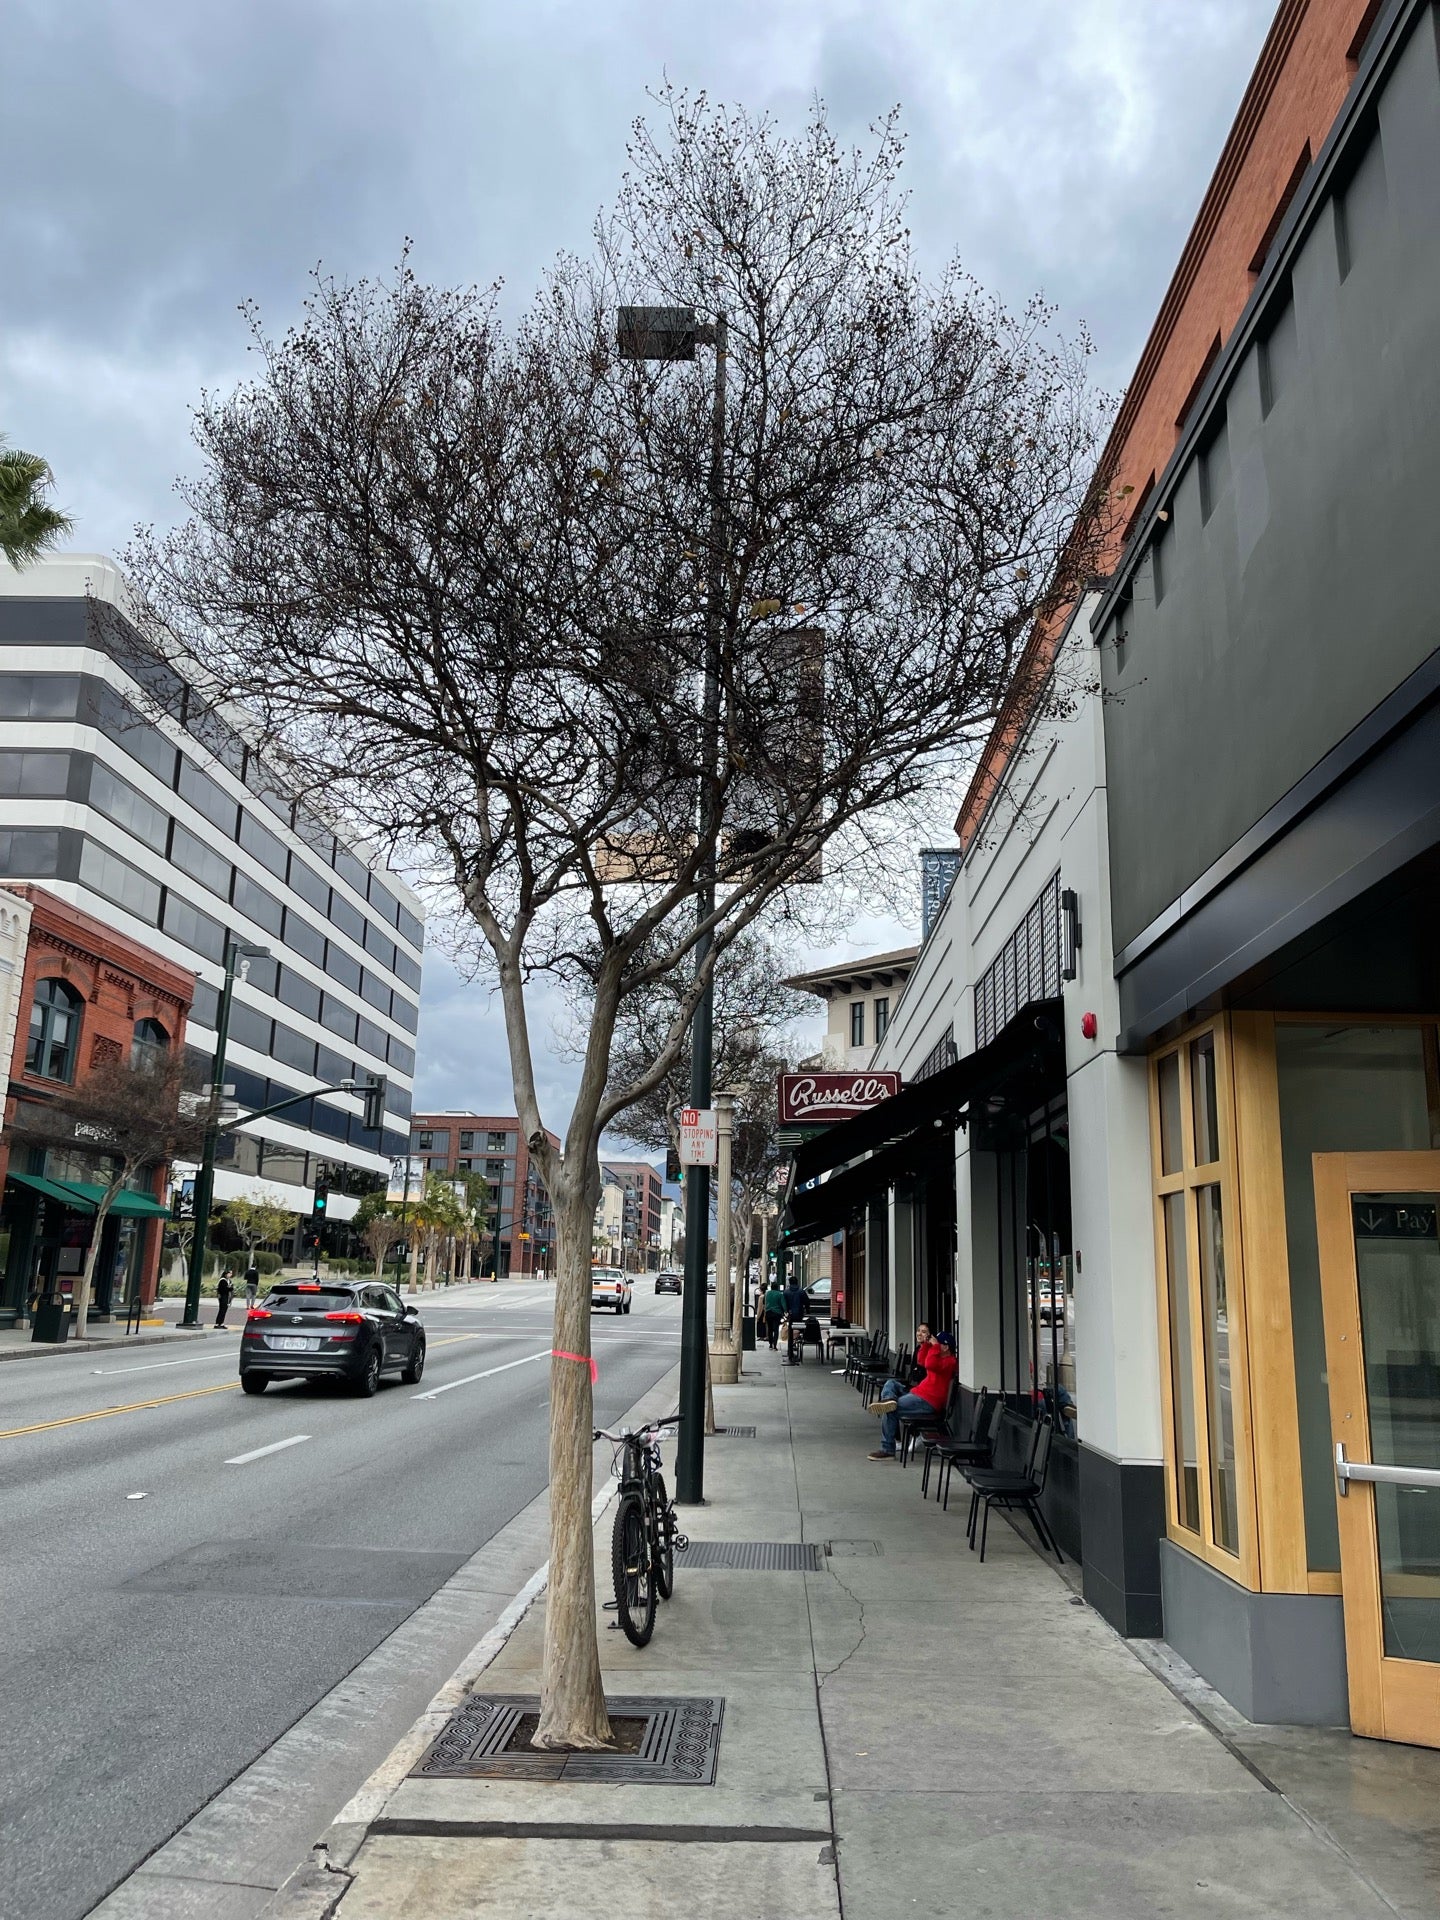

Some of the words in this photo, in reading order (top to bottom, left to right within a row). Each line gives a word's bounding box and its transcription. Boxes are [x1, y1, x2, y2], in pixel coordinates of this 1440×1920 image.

[790, 1078, 891, 1106] Russell's
[683, 1112, 696, 1124] NO
[684, 1129, 714, 1139] STOPPING
[691, 1141, 705, 1149] ANY
[691, 1151, 705, 1159] TIME
[1396, 1209, 1432, 1233] Pay
